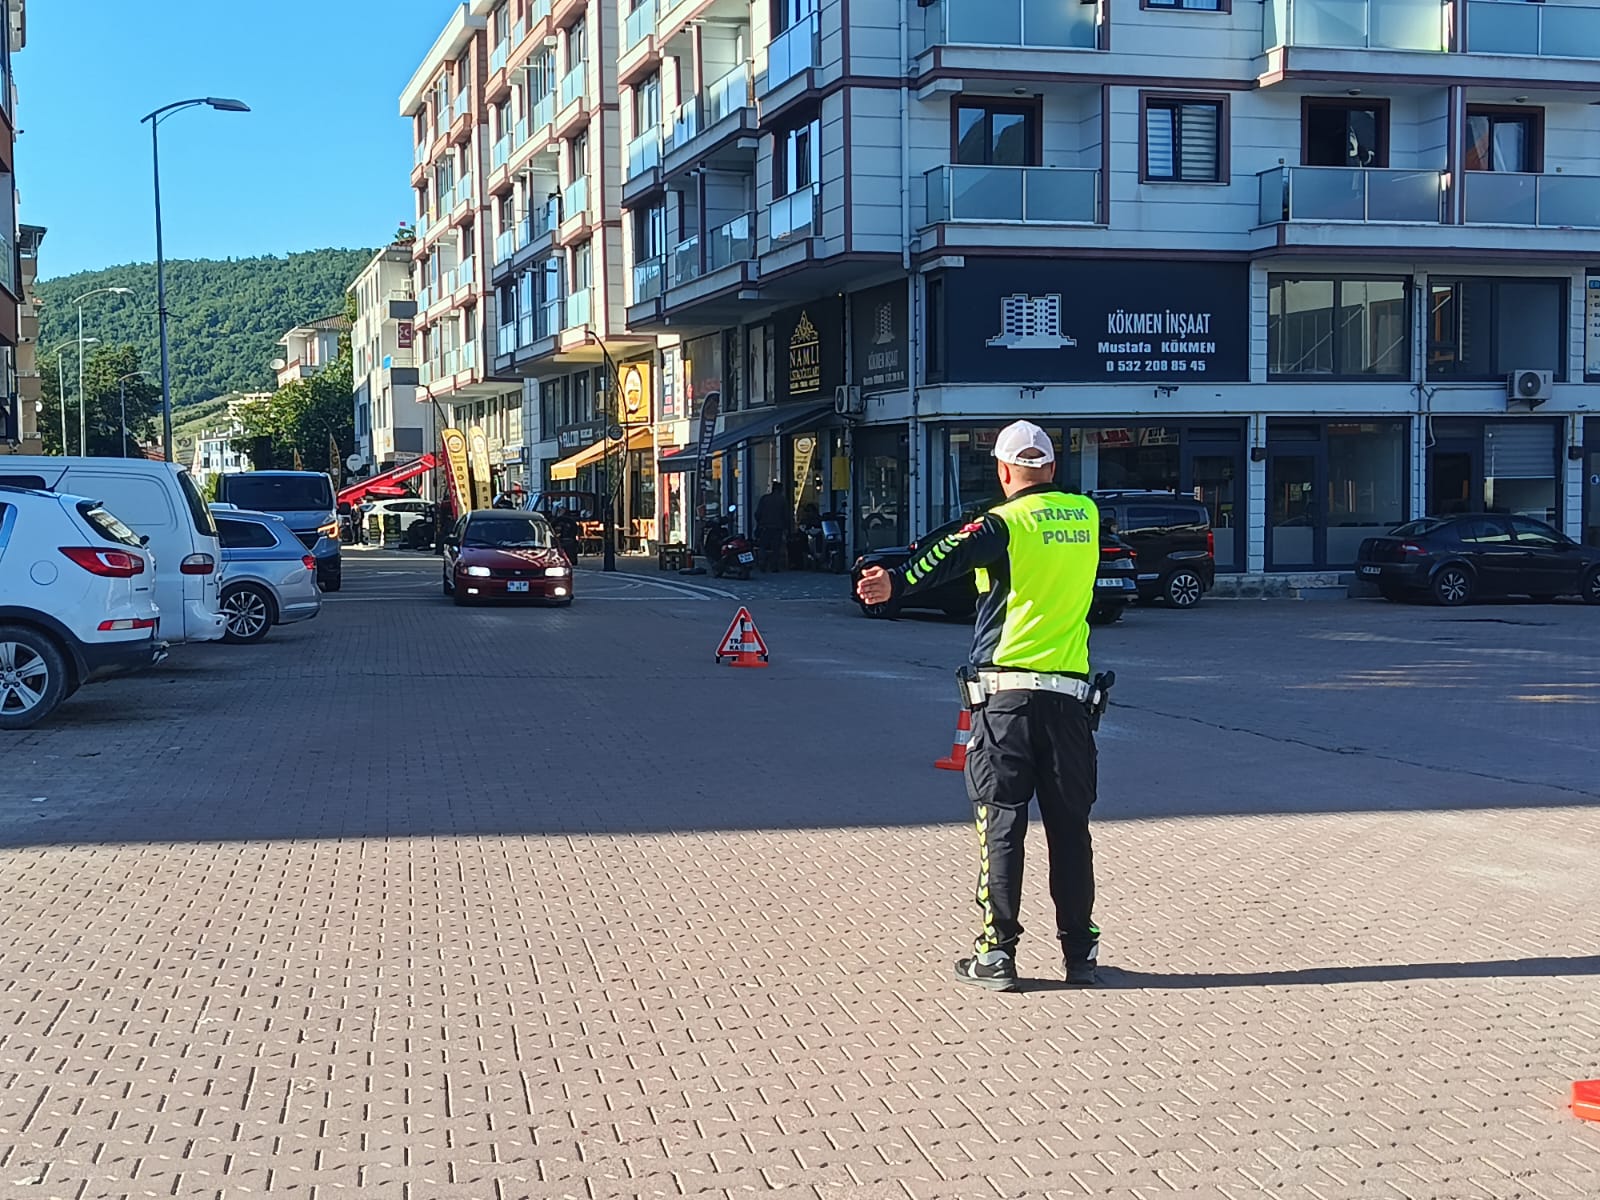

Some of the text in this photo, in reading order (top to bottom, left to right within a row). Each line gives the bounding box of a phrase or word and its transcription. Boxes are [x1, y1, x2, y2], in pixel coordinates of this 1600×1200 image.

[1107, 309, 1211, 339] KÖKMEN İNŞAAT
[1097, 339, 1216, 353] Mustafa KÖKMEN
[1106, 360, 1114, 372] 0
[1117, 360, 1141, 372] 532
[1189, 360, 1206, 371] 45
